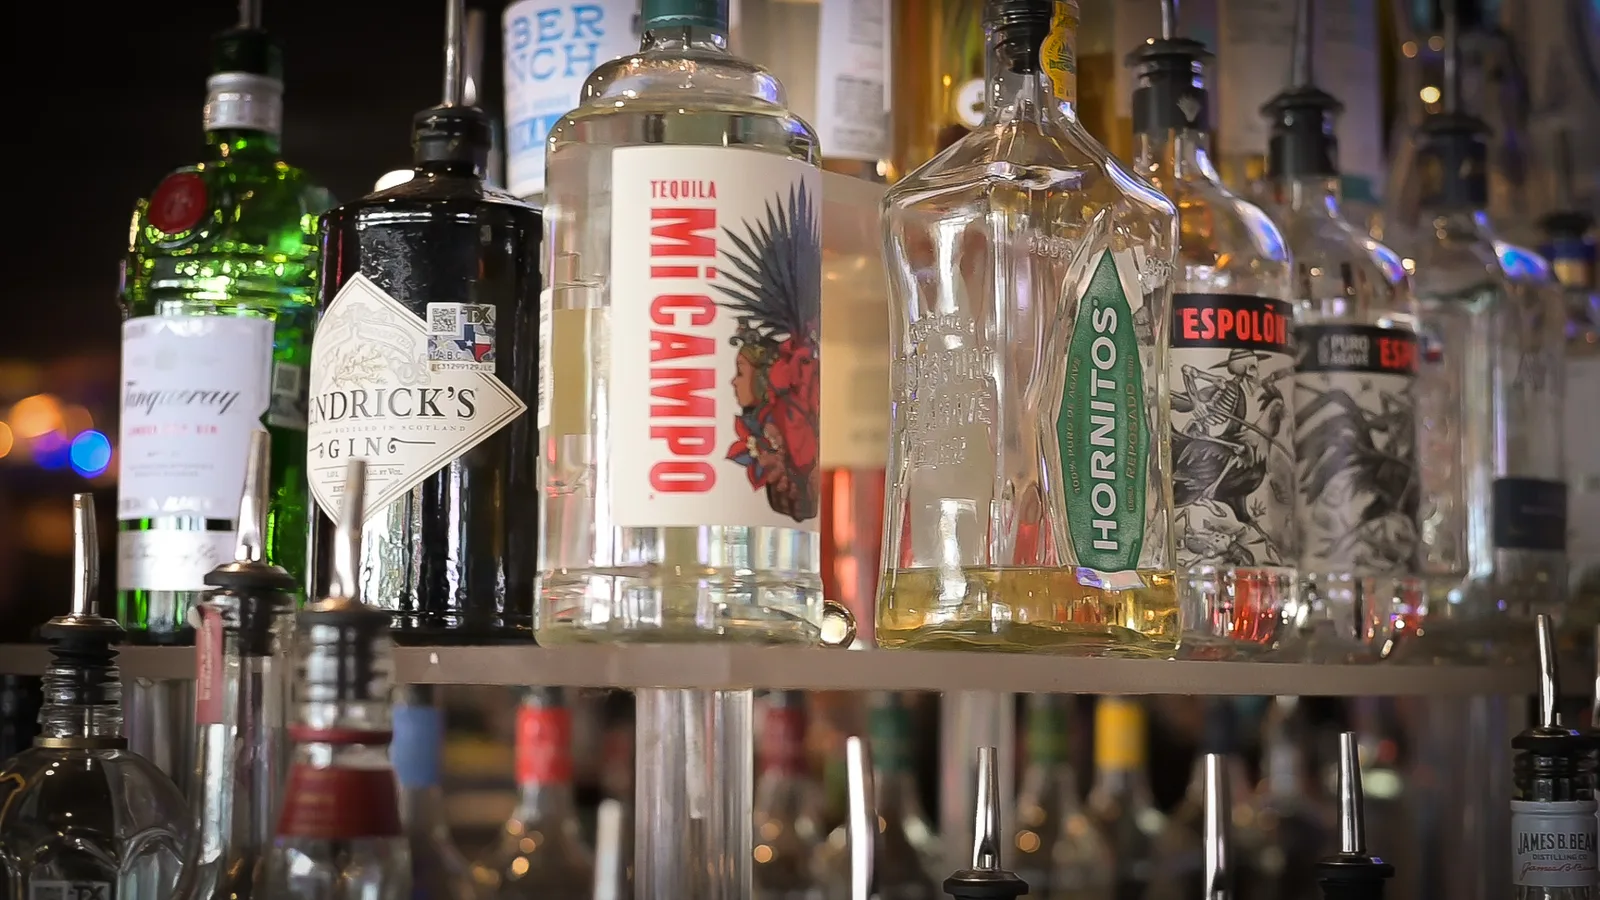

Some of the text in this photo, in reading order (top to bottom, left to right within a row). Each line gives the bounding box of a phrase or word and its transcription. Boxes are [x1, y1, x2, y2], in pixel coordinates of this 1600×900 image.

[650, 180, 717, 199] TEQUILA
[464, 306, 493, 325] TX
[124, 380, 241, 416] Tanqueray
[650, 294, 717, 493] CAMPO
[401, 424, 467, 432] SCOTLAND
[1090, 304, 1119, 551] HORNITOS
[1125, 383, 1139, 479] REPOSADO
[328, 437, 382, 459] GIN
[1518, 832, 1555, 855] JAMES
[1532, 853, 1577, 861] DISTILLING
